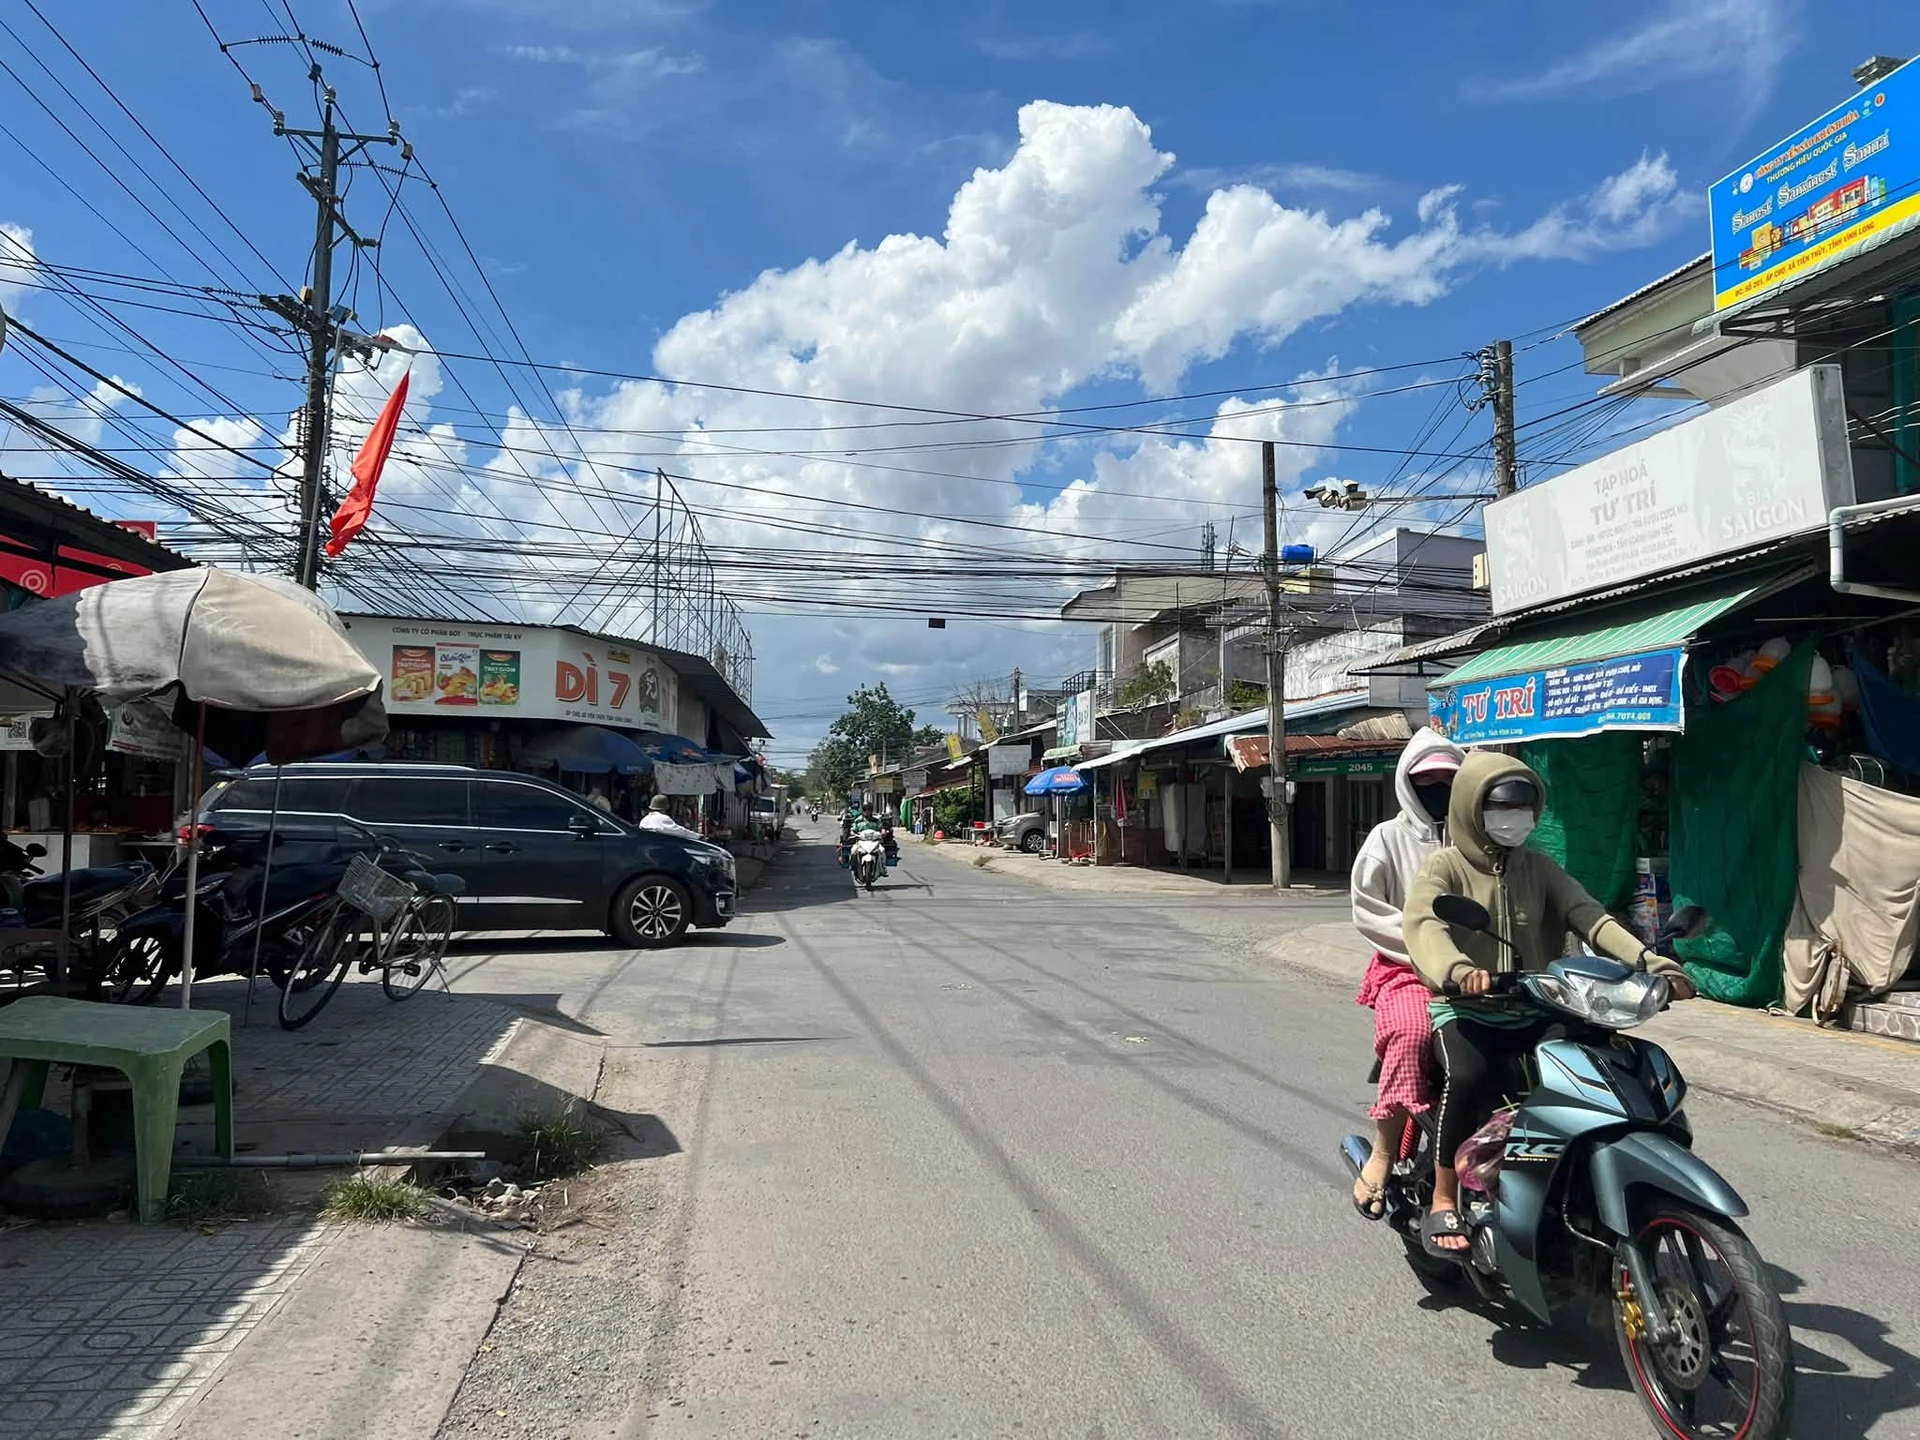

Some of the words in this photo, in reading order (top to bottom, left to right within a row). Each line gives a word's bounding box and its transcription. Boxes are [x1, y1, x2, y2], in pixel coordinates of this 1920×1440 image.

[1813, 141, 1833, 158] QUỐC
[1834, 131, 1848, 145] GIA
[1858, 222, 1875, 237] LONG
[1594, 474, 1617, 497] TẠP
[1590, 496, 1619, 526] TƯ
[1622, 479, 1657, 515] TRÍ
[1721, 496, 1809, 541] SAIGON
[1497, 574, 1549, 603] SAIGON
[555, 651, 598, 706] DÌ
[608, 670, 632, 710] 7
[1462, 686, 1491, 724] TƯ
[1494, 676, 1535, 720] TRÍ
[1347, 762, 1374, 772] 2045
